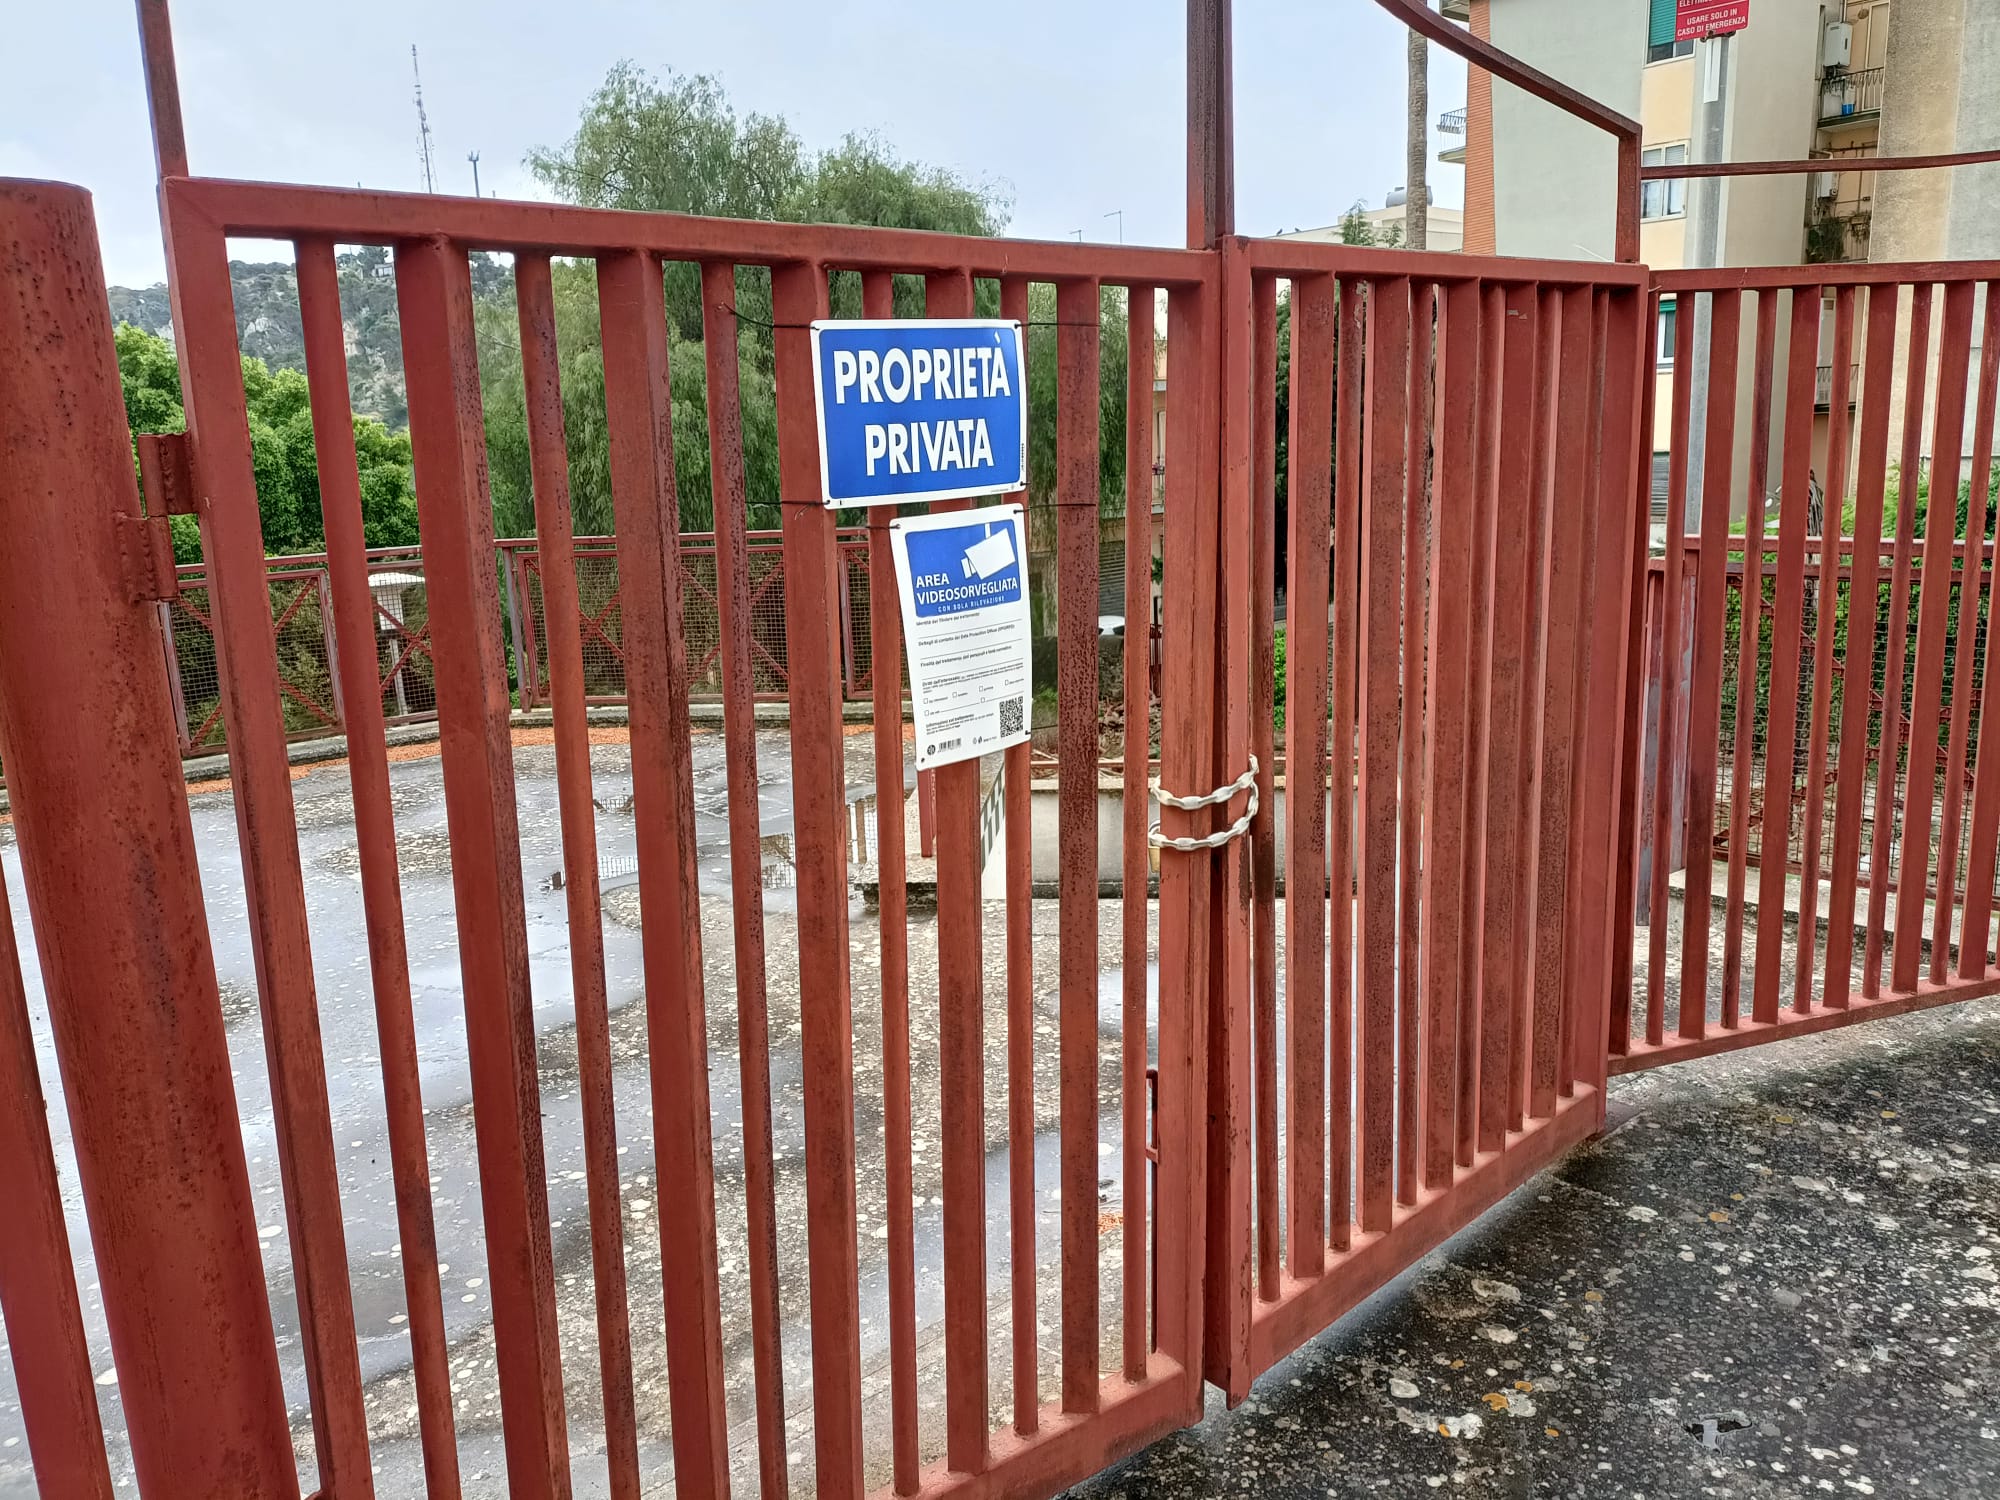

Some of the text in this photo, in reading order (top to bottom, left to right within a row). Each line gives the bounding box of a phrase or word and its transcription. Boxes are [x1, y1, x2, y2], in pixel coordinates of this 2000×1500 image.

[1677, 27, 1695, 36] CASO
[1706, 16, 1746, 31] EMERGENZA
[1687, 8, 1737, 25] USARE SOLO IN
[833, 331, 1011, 404] PROPRIETÀ
[865, 418, 994, 477] PRIVATA
[916, 573, 950, 589] AREA
[916, 577, 1018, 605] VIDEOSORVEGLIATA
[938, 603, 951, 613] CON
[970, 596, 1005, 608] RILEVAZIONE
